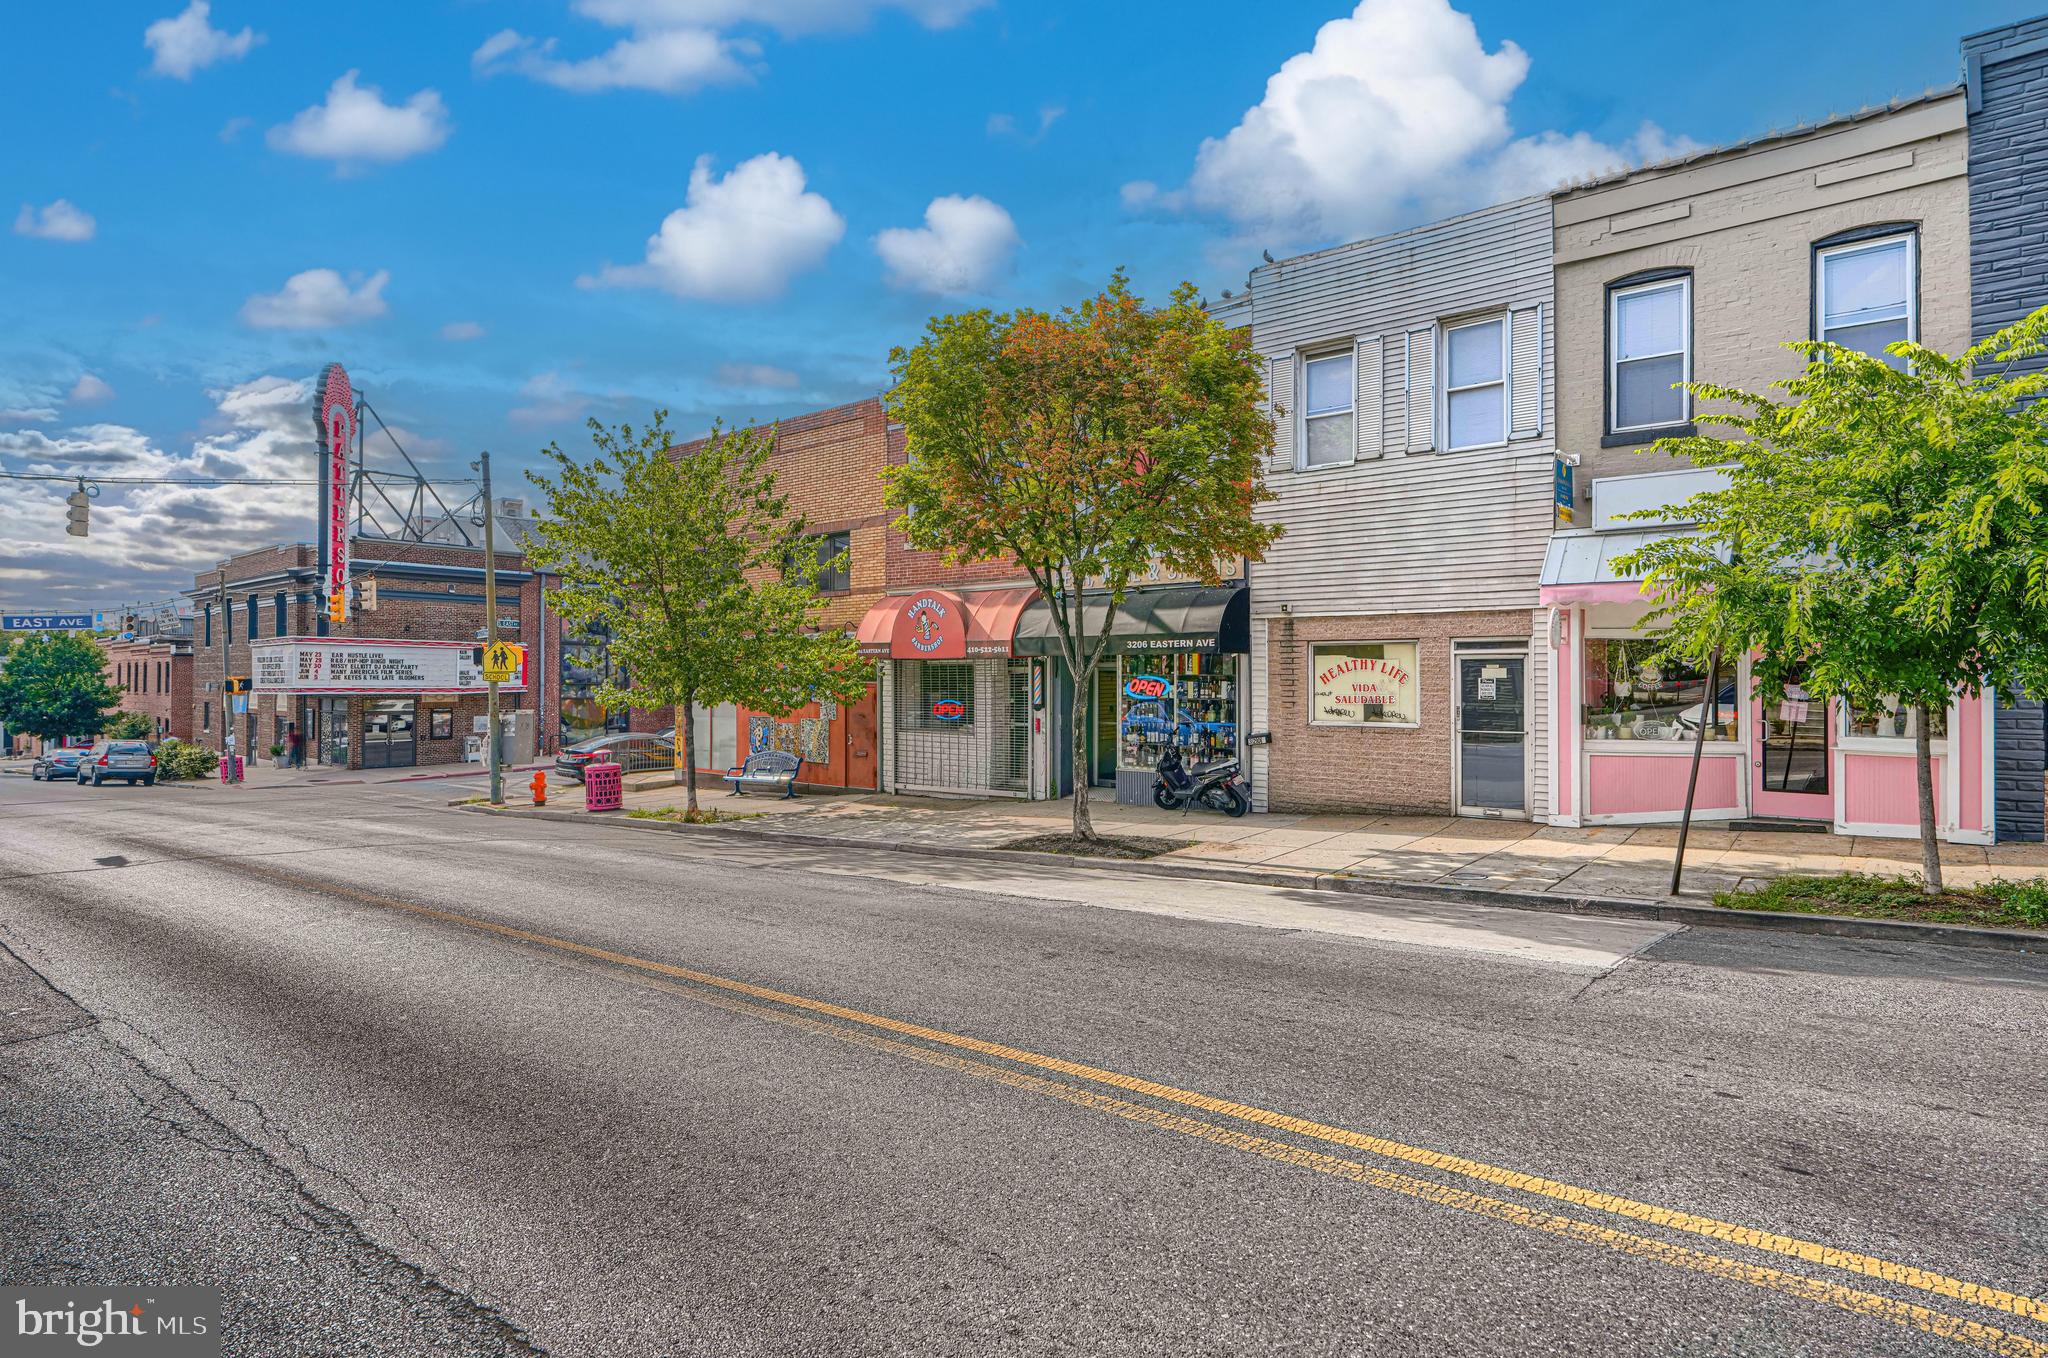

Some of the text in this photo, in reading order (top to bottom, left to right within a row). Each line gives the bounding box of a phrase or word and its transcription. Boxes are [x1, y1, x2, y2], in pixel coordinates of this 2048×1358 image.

[337, 420, 345, 585] PATTERSO
[908, 598, 946, 619] HANDTALK
[13, 618, 86, 628] EAST AVE.
[911, 635, 944, 652] BARBERSHOP
[1126, 638, 1215, 648] 3206 EASTERN AVE
[1319, 659, 1409, 685] HEALTHY LIFE
[1129, 678, 1166, 697] OPEN
[1352, 683, 1377, 692] VIDA
[1335, 695, 1395, 704] SALUDABLE
[933, 704, 964, 717] OPEN
